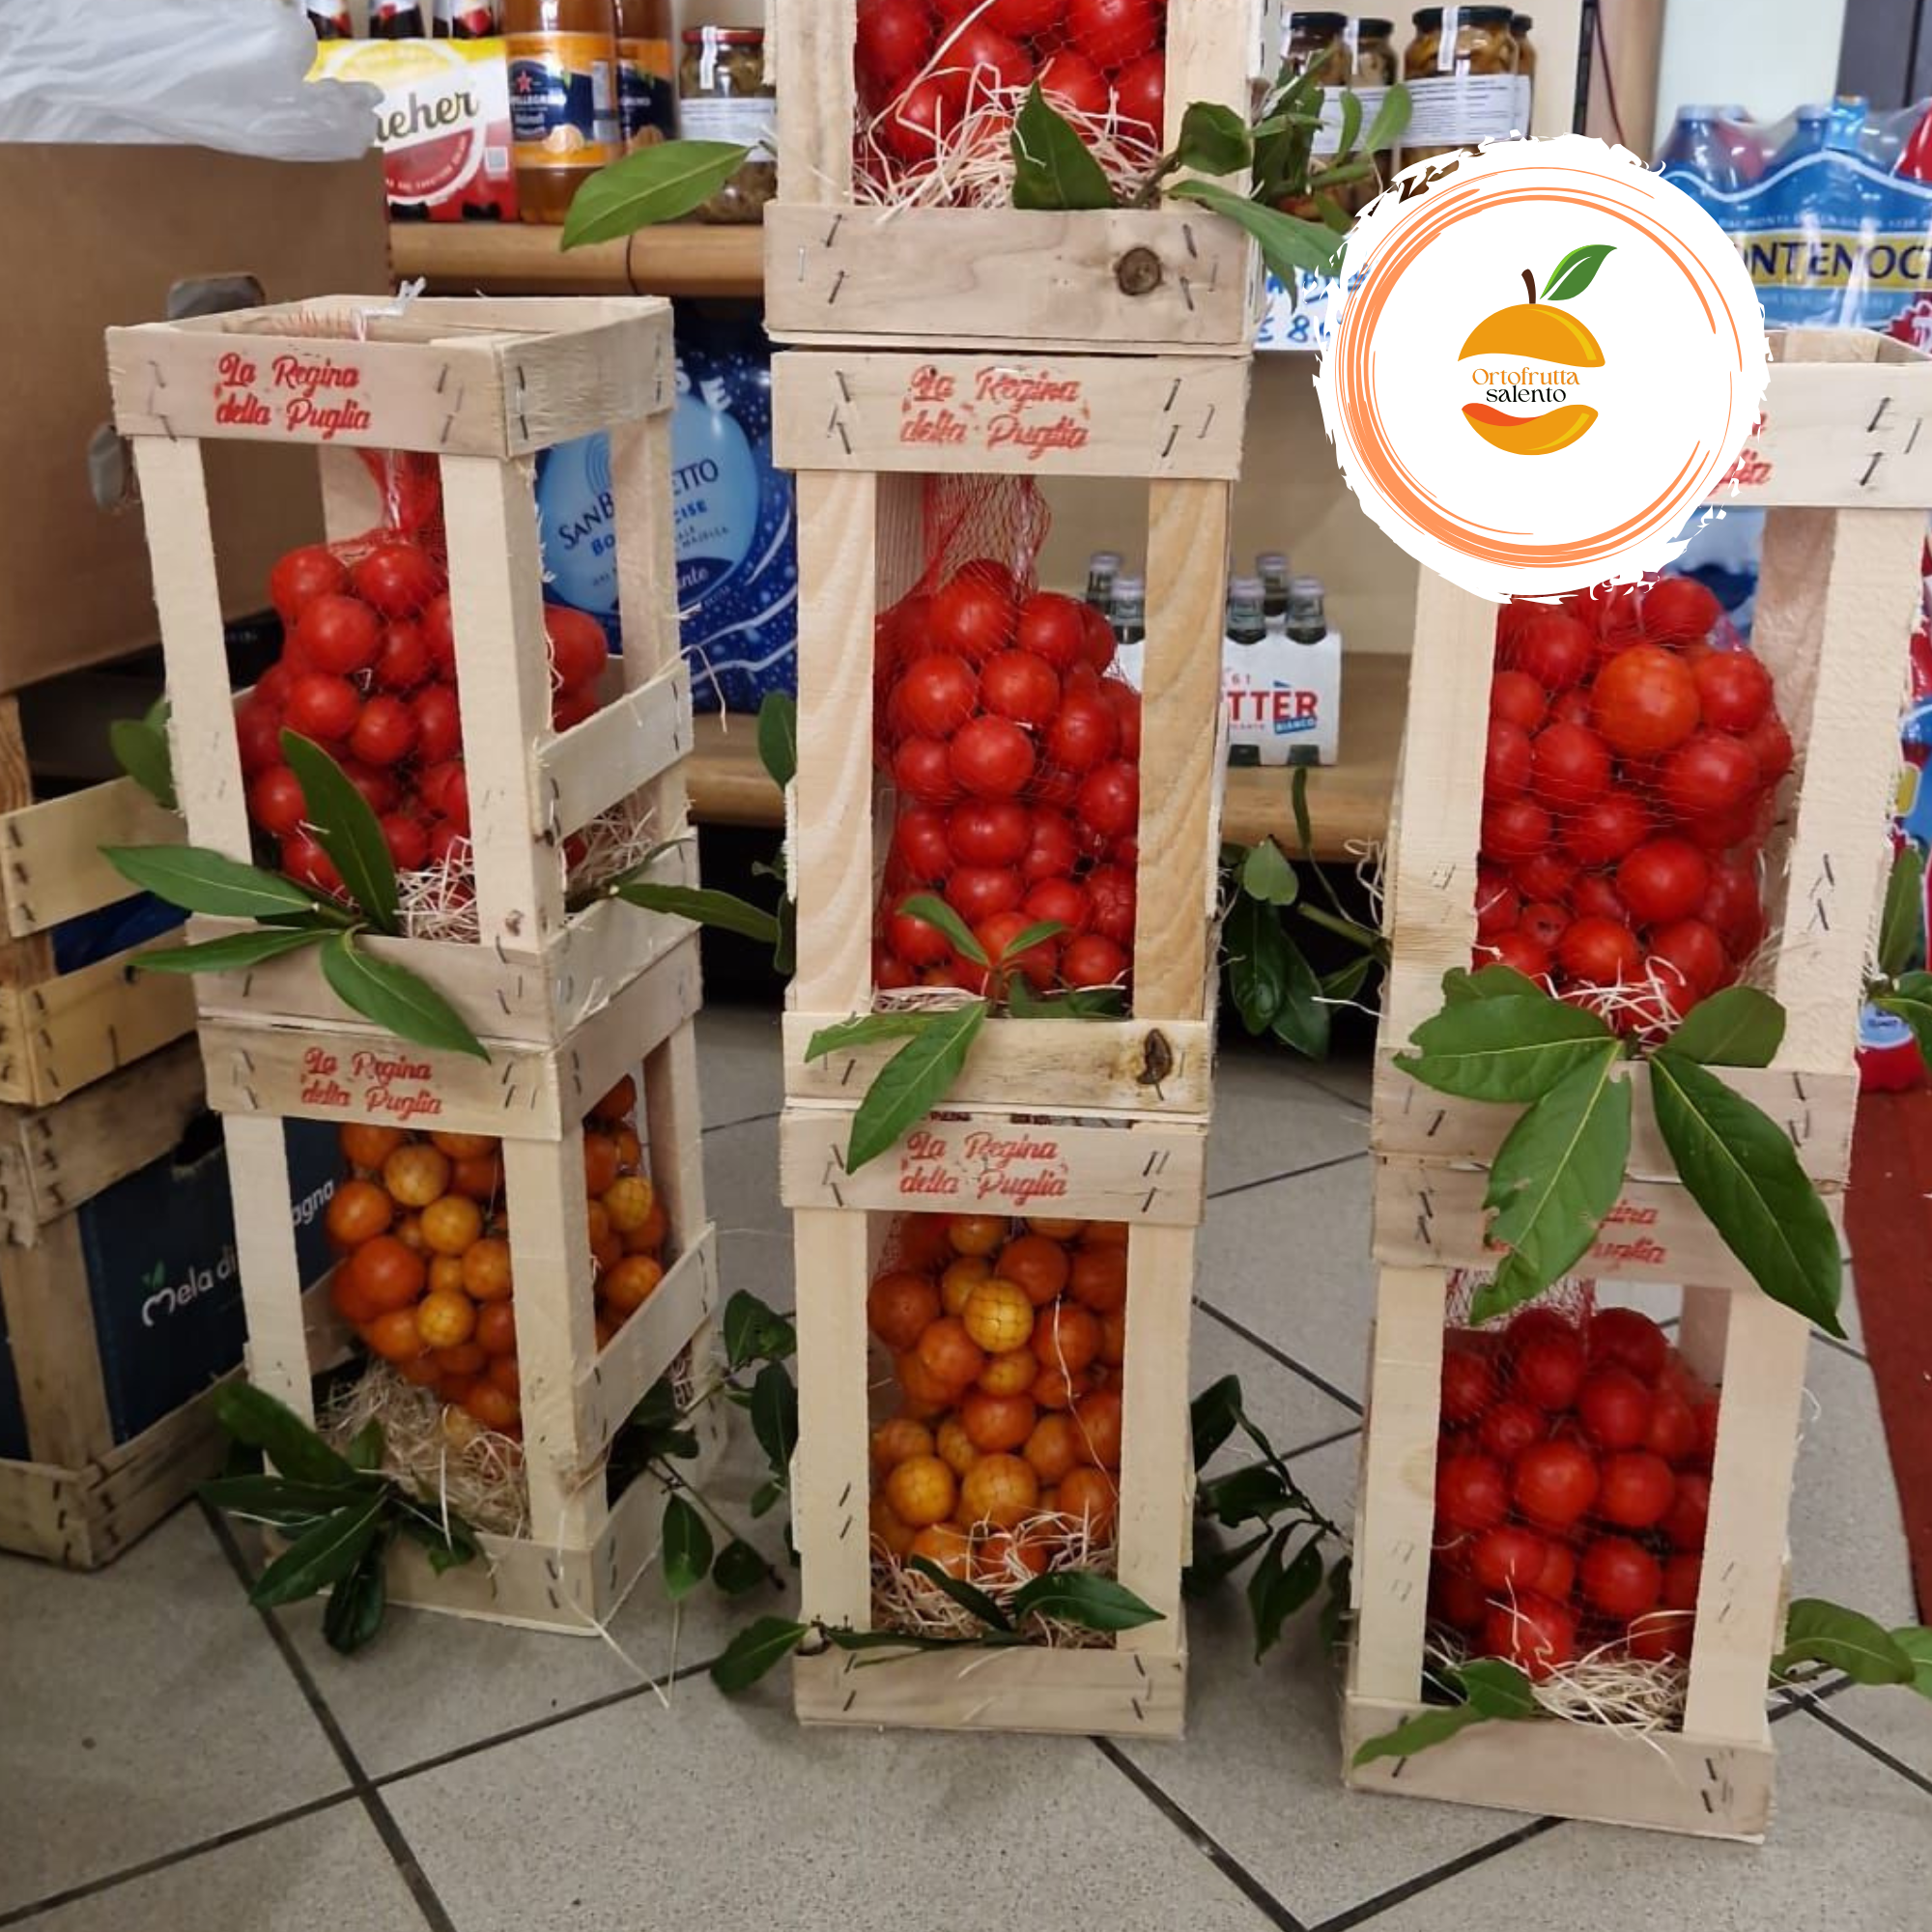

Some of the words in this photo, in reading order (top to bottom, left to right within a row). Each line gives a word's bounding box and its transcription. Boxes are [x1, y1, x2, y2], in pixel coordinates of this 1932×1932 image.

[377, 92, 478, 142] reher
[1742, 242, 1932, 280] NTENOC
[219, 352, 256, 388] La
[271, 354, 361, 399] Regina
[911, 365, 954, 402] La
[976, 366, 1080, 413] Regina
[215, 392, 271, 426] della
[286, 398, 372, 441] Puglia
[900, 409, 967, 442] della
[987, 413, 1089, 461] Puglia
[1227, 690, 1319, 722] TTER
[304, 1046, 337, 1075] La
[352, 1050, 432, 1085] Regina
[301, 1080, 352, 1107] della
[365, 1085, 442, 1122] Puglia
[907, 1130, 947, 1160] La
[964, 1131, 1059, 1169] Regina
[899, 1166, 959, 1194] della
[978, 1168, 1068, 1207] Puglia
[141, 1264, 214, 1327] Mela
[292, 1178, 335, 1226] agna
[1592, 1236, 1667, 1272] uglia
